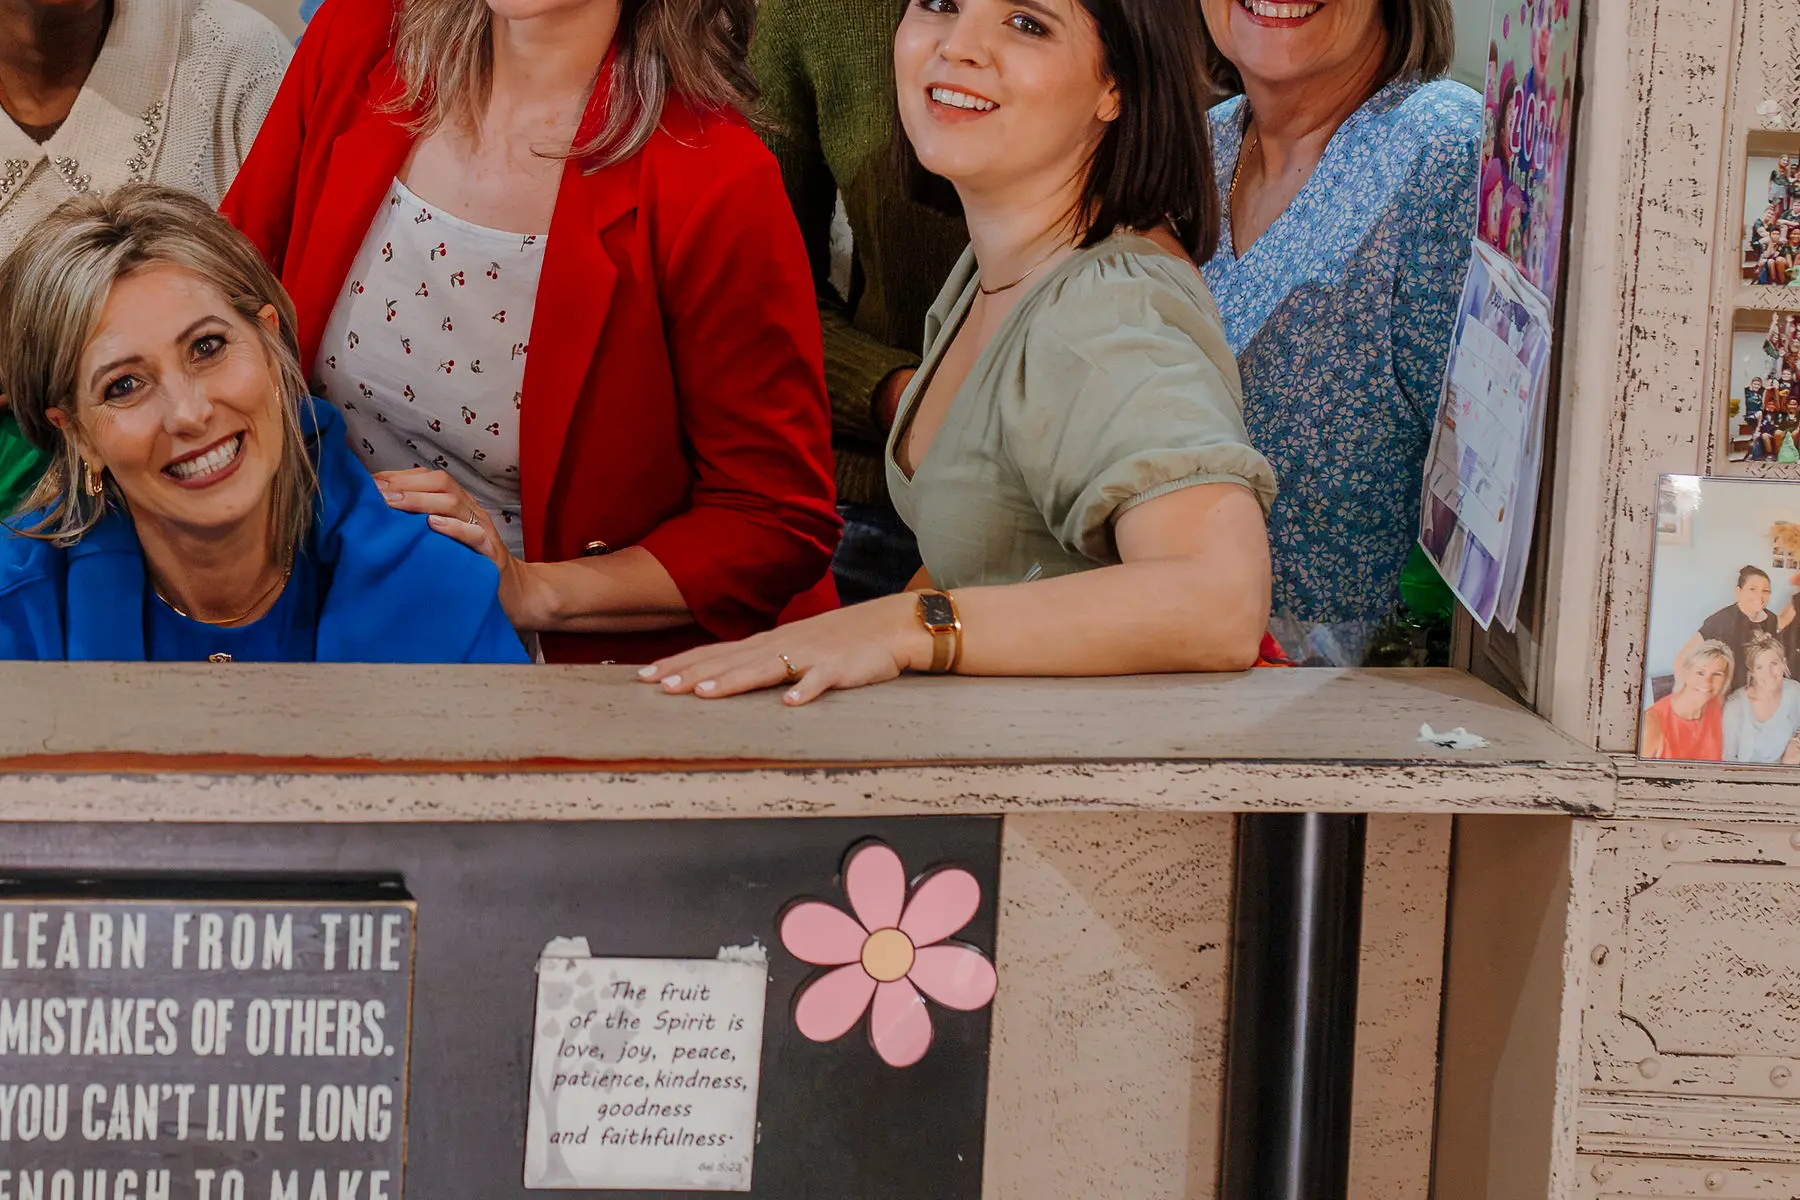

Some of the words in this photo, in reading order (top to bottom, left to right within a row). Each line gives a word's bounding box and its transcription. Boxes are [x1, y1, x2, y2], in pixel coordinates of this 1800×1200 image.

[1, 912, 146, 970] LEARN
[172, 913, 293, 971] FROM
[321, 914, 401, 971] THE
[611, 981, 646, 1000] The
[660, 983, 711, 1001] fruit
[191, 999, 234, 1055] OF
[246, 999, 394, 1057] OTHERS.
[570, 1011, 597, 1028] of
[606, 1011, 641, 1029] the
[653, 1010, 716, 1034] Spirit
[728, 1014, 744, 1031] is
[557, 1039, 605, 1060] love,
[617, 1041, 656, 1063] joy,
[672, 1047, 736, 1063] peace,
[553, 1071, 649, 1091] patience,
[655, 1070, 747, 1092] kindness,
[206, 1084, 285, 1141] LIVE
[299, 1085, 392, 1142] LONG
[598, 1098, 692, 1121] goodness
[550, 1126, 589, 1145] and
[195, 1169, 244, 1200] TO
[270, 1169, 389, 1200] MAKE
